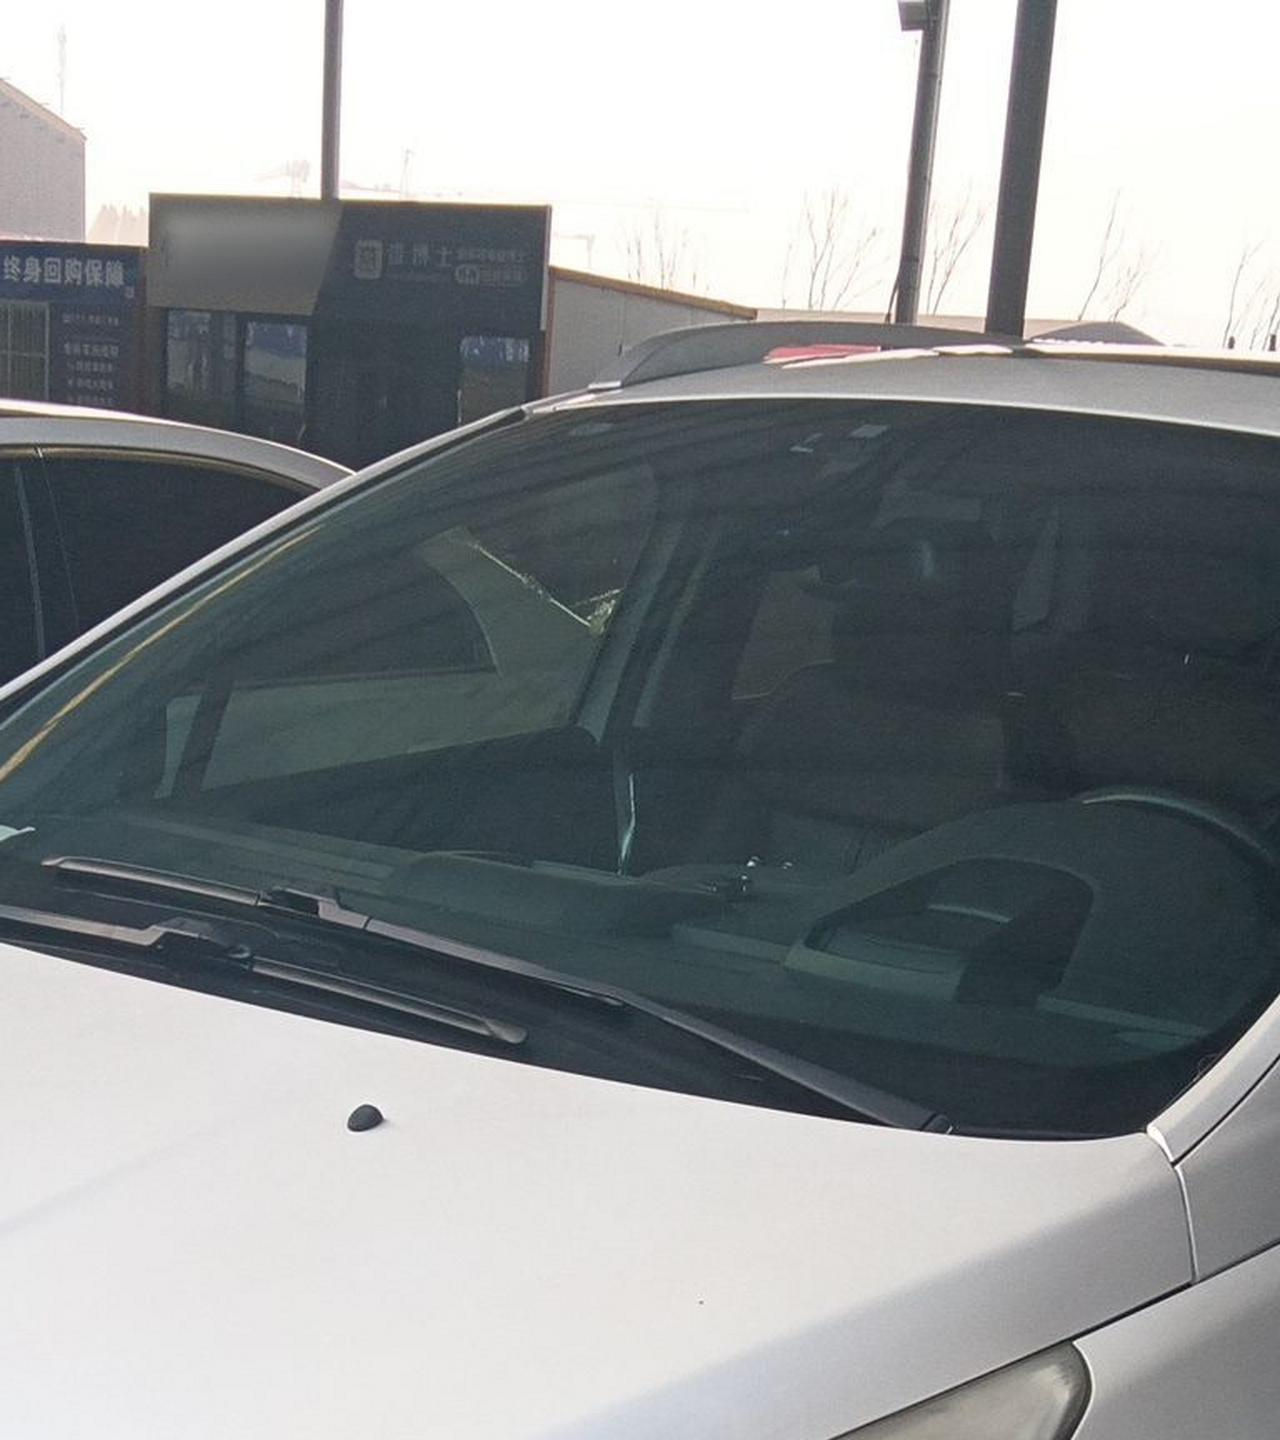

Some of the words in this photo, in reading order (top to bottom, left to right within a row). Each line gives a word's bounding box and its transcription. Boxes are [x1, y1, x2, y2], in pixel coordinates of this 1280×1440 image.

[3, 255, 125, 288] 终身回购保障
